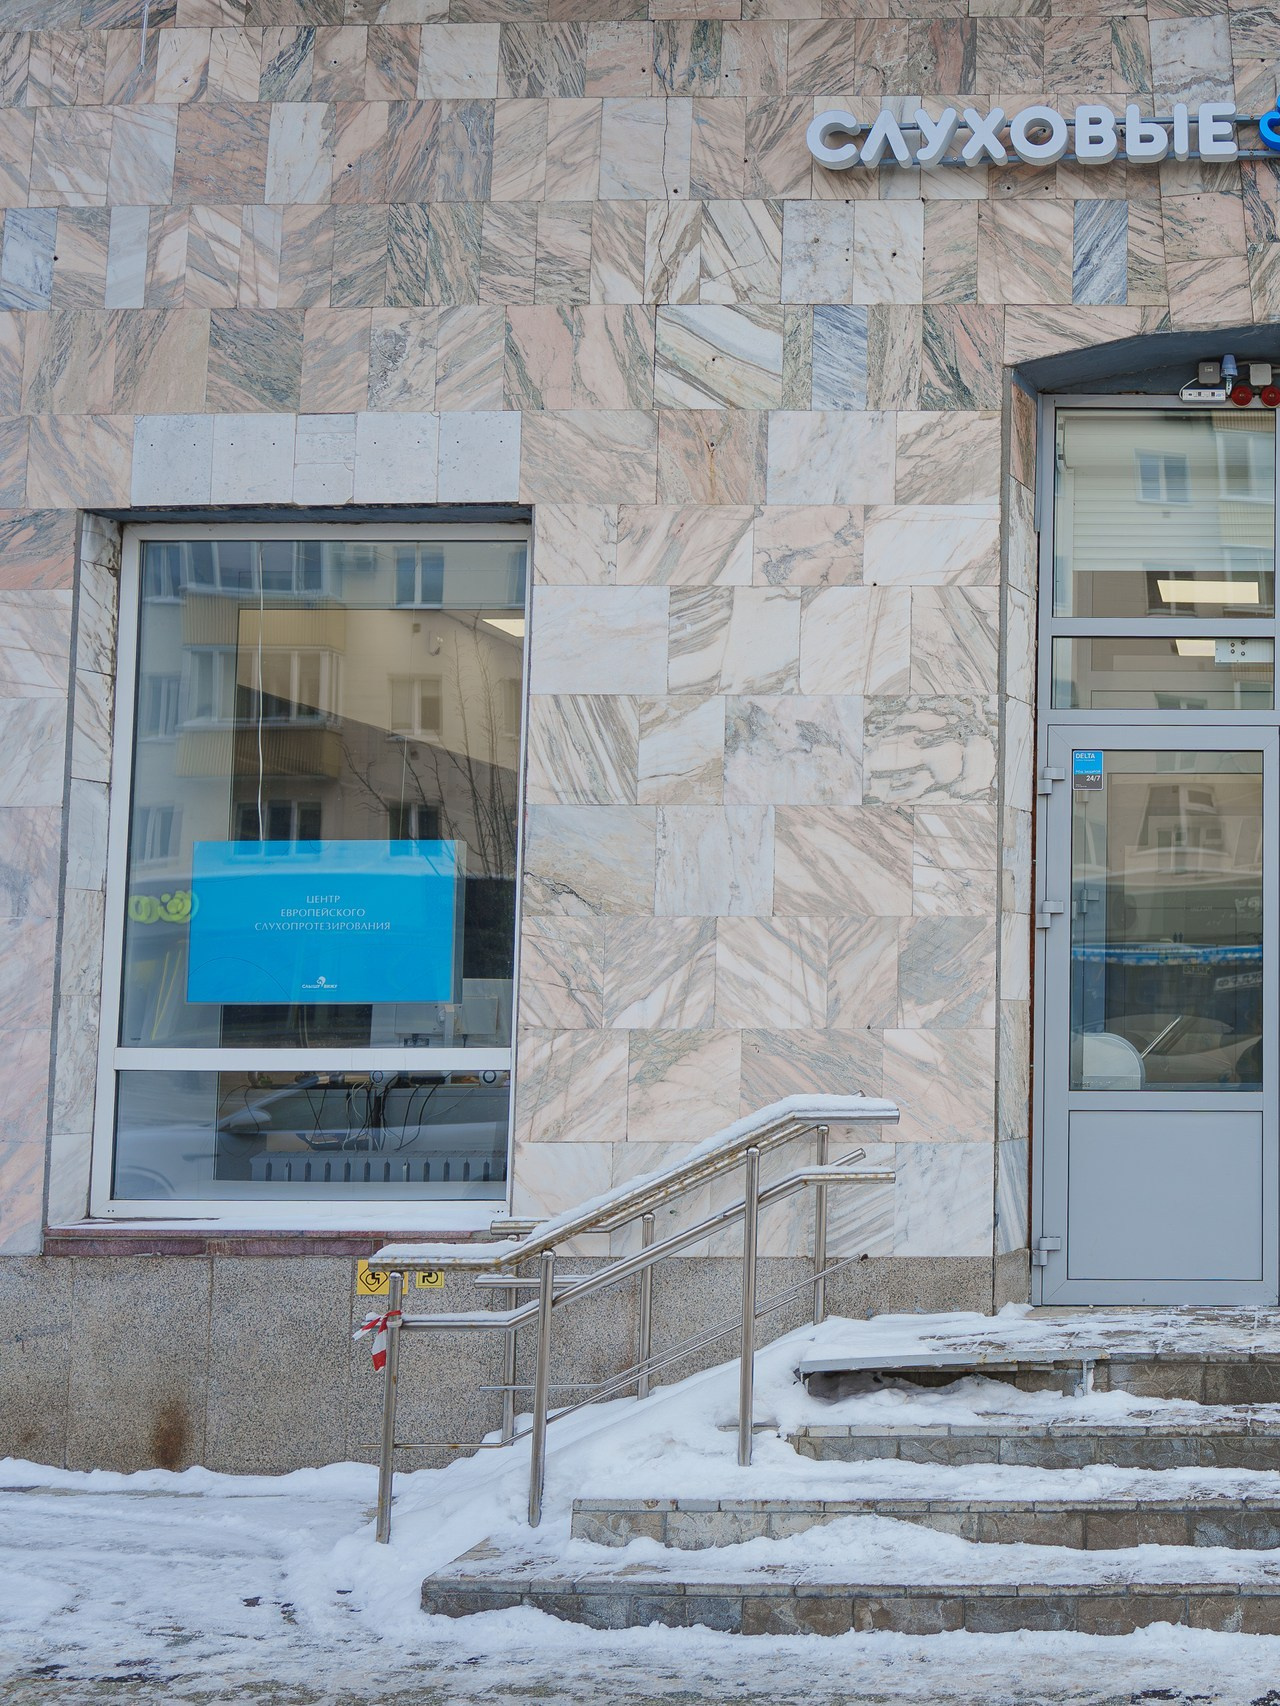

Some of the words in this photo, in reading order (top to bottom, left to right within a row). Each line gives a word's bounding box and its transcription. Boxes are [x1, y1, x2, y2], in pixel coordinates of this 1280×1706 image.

[806, 102, 1239, 170] СЛУХОВЫЕ
[306, 895, 341, 904] ЦЕНТР
[280, 908, 366, 917] ЕВРОПЕЙСКОГО
[254, 922, 391, 931] СЛУХОПРОТЕЗИРОВАНИЯ
